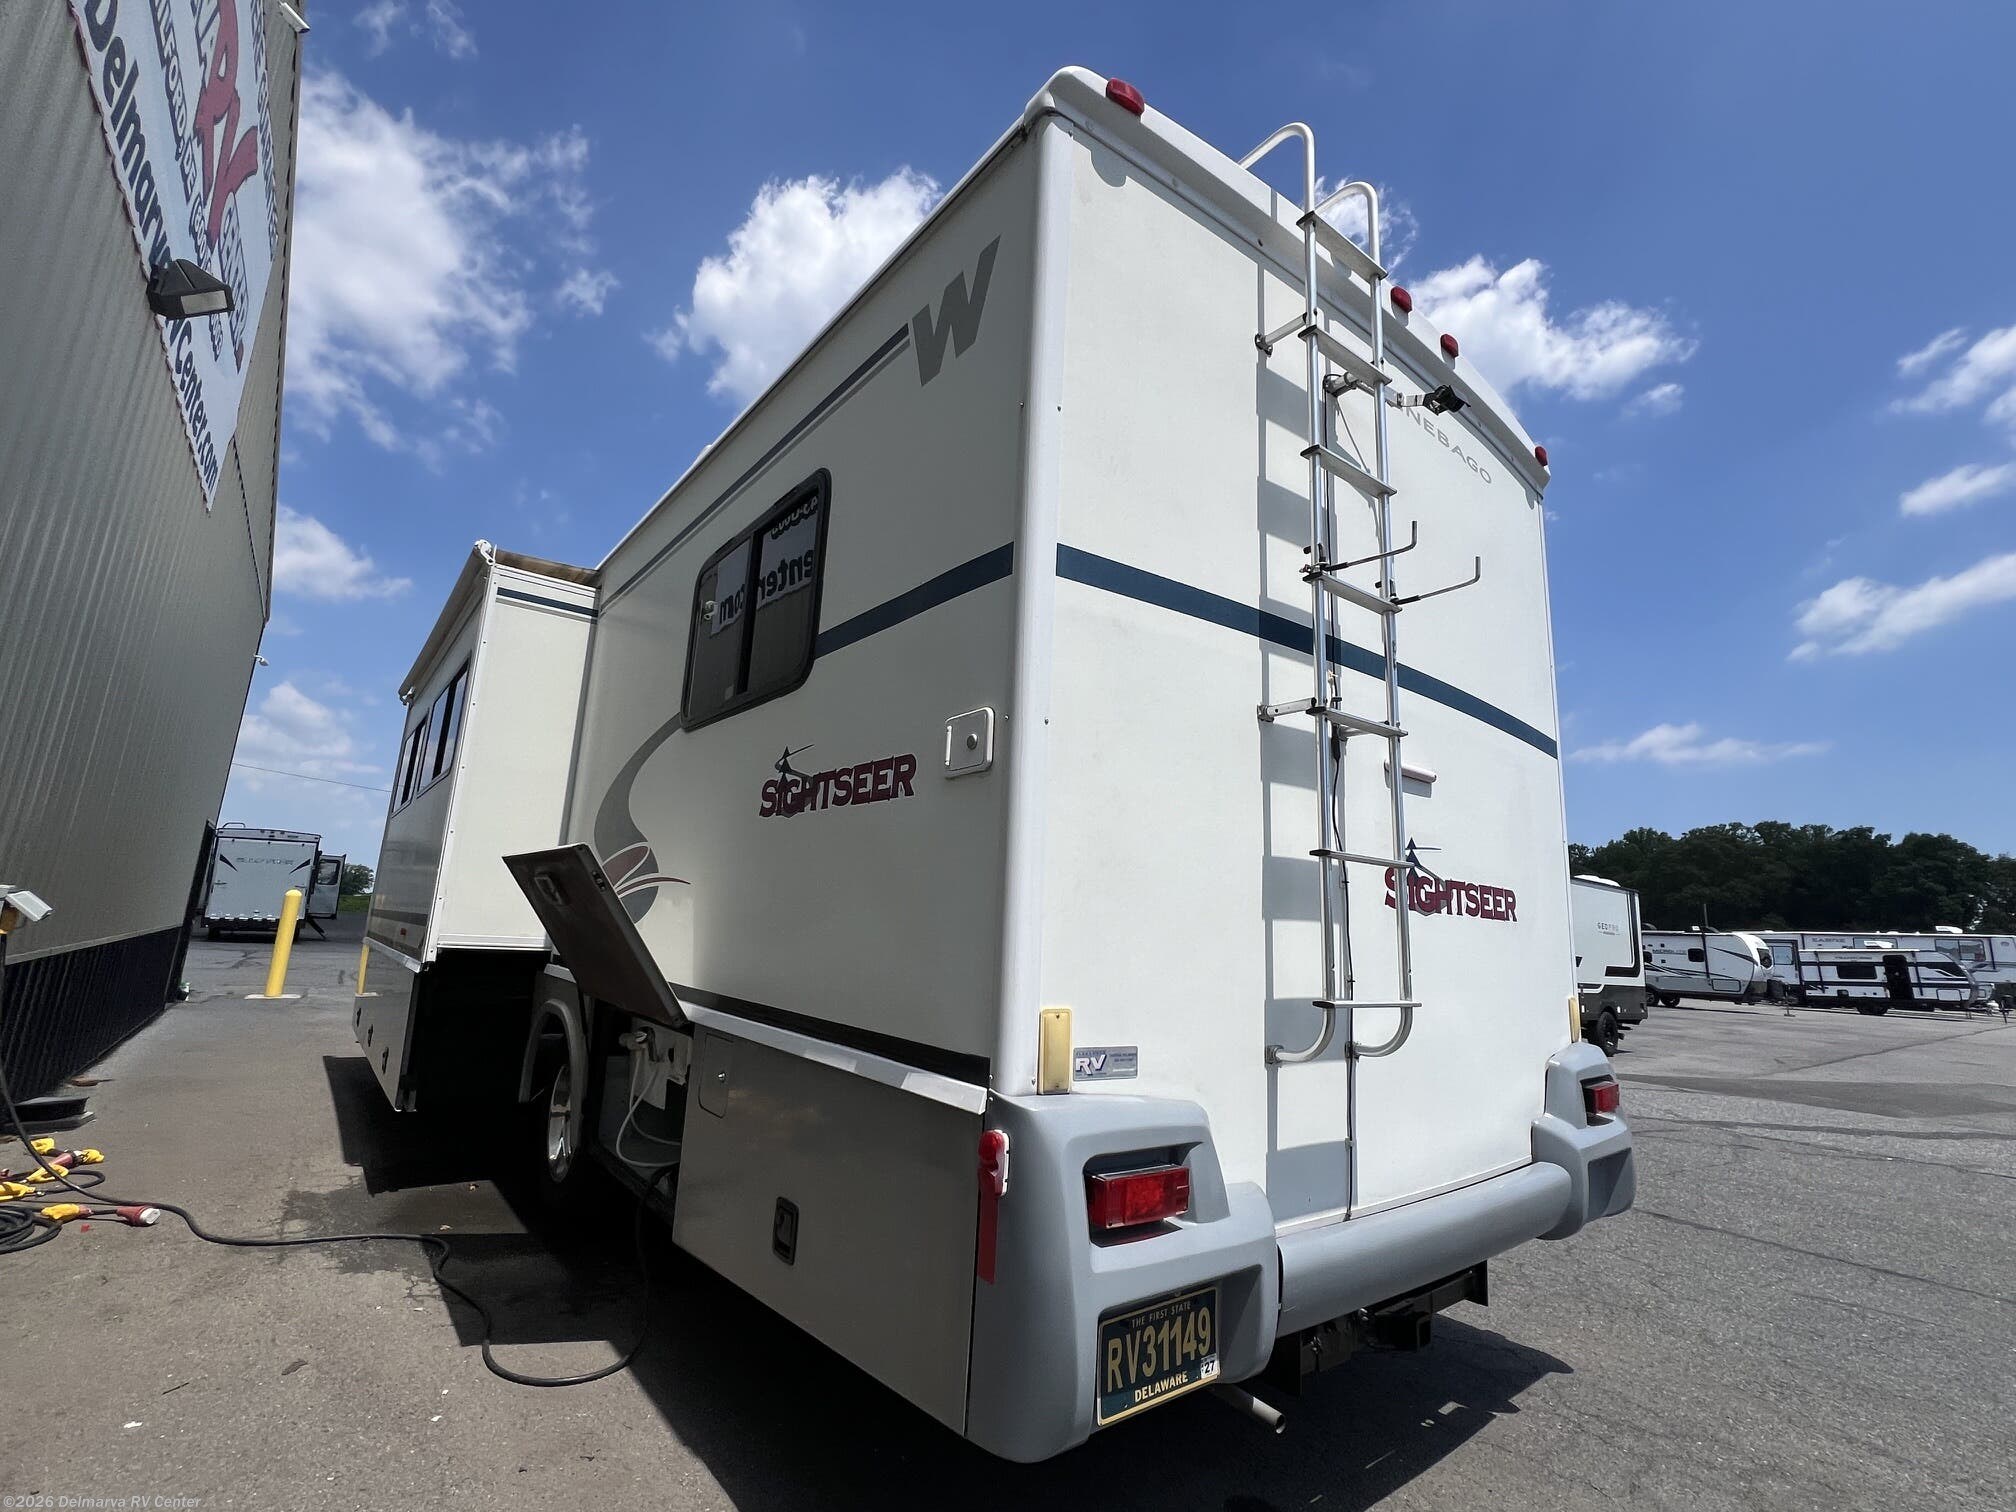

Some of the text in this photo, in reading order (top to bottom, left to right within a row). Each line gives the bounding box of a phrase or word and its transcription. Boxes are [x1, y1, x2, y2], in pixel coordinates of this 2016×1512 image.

[149, 0, 188, 162] ILFORD,
[912, 234, 1001, 387] W
[758, 753, 918, 818] SIGHTSEER
[1075, 1054, 1107, 1076] RV
[1132, 1301, 1191, 1329] THE FIRST STATE
[1107, 1306, 1211, 1393] RV31149
[1204, 1360, 1215, 1374] 27
[1134, 1370, 1189, 1403] DELAWARE
